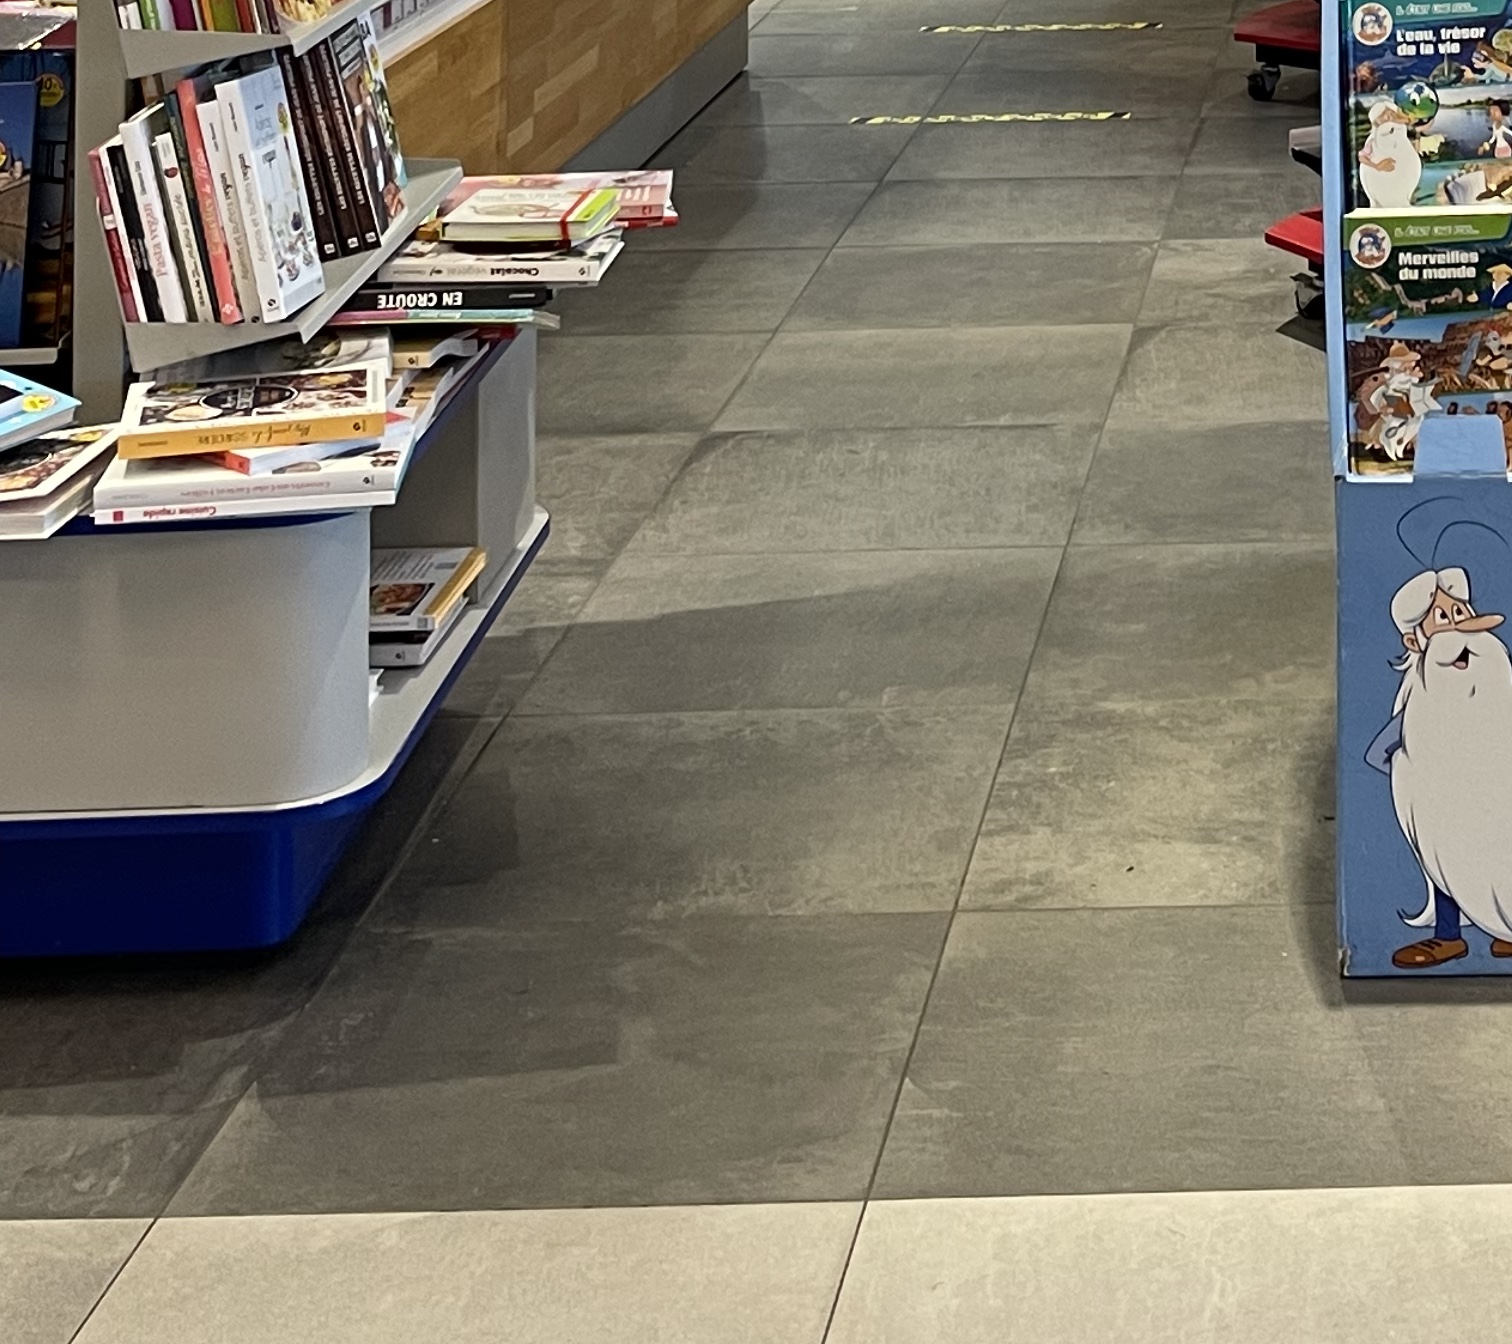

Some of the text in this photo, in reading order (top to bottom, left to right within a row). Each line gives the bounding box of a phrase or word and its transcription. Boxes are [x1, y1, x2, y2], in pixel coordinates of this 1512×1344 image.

[1397, 41, 1461, 56] de la vie
[1398, 250, 1479, 266] Merveilles
[489, 267, 539, 277] Chocolat
[1399, 265, 1476, 280] du monde
[442, 292, 462, 306] EN
